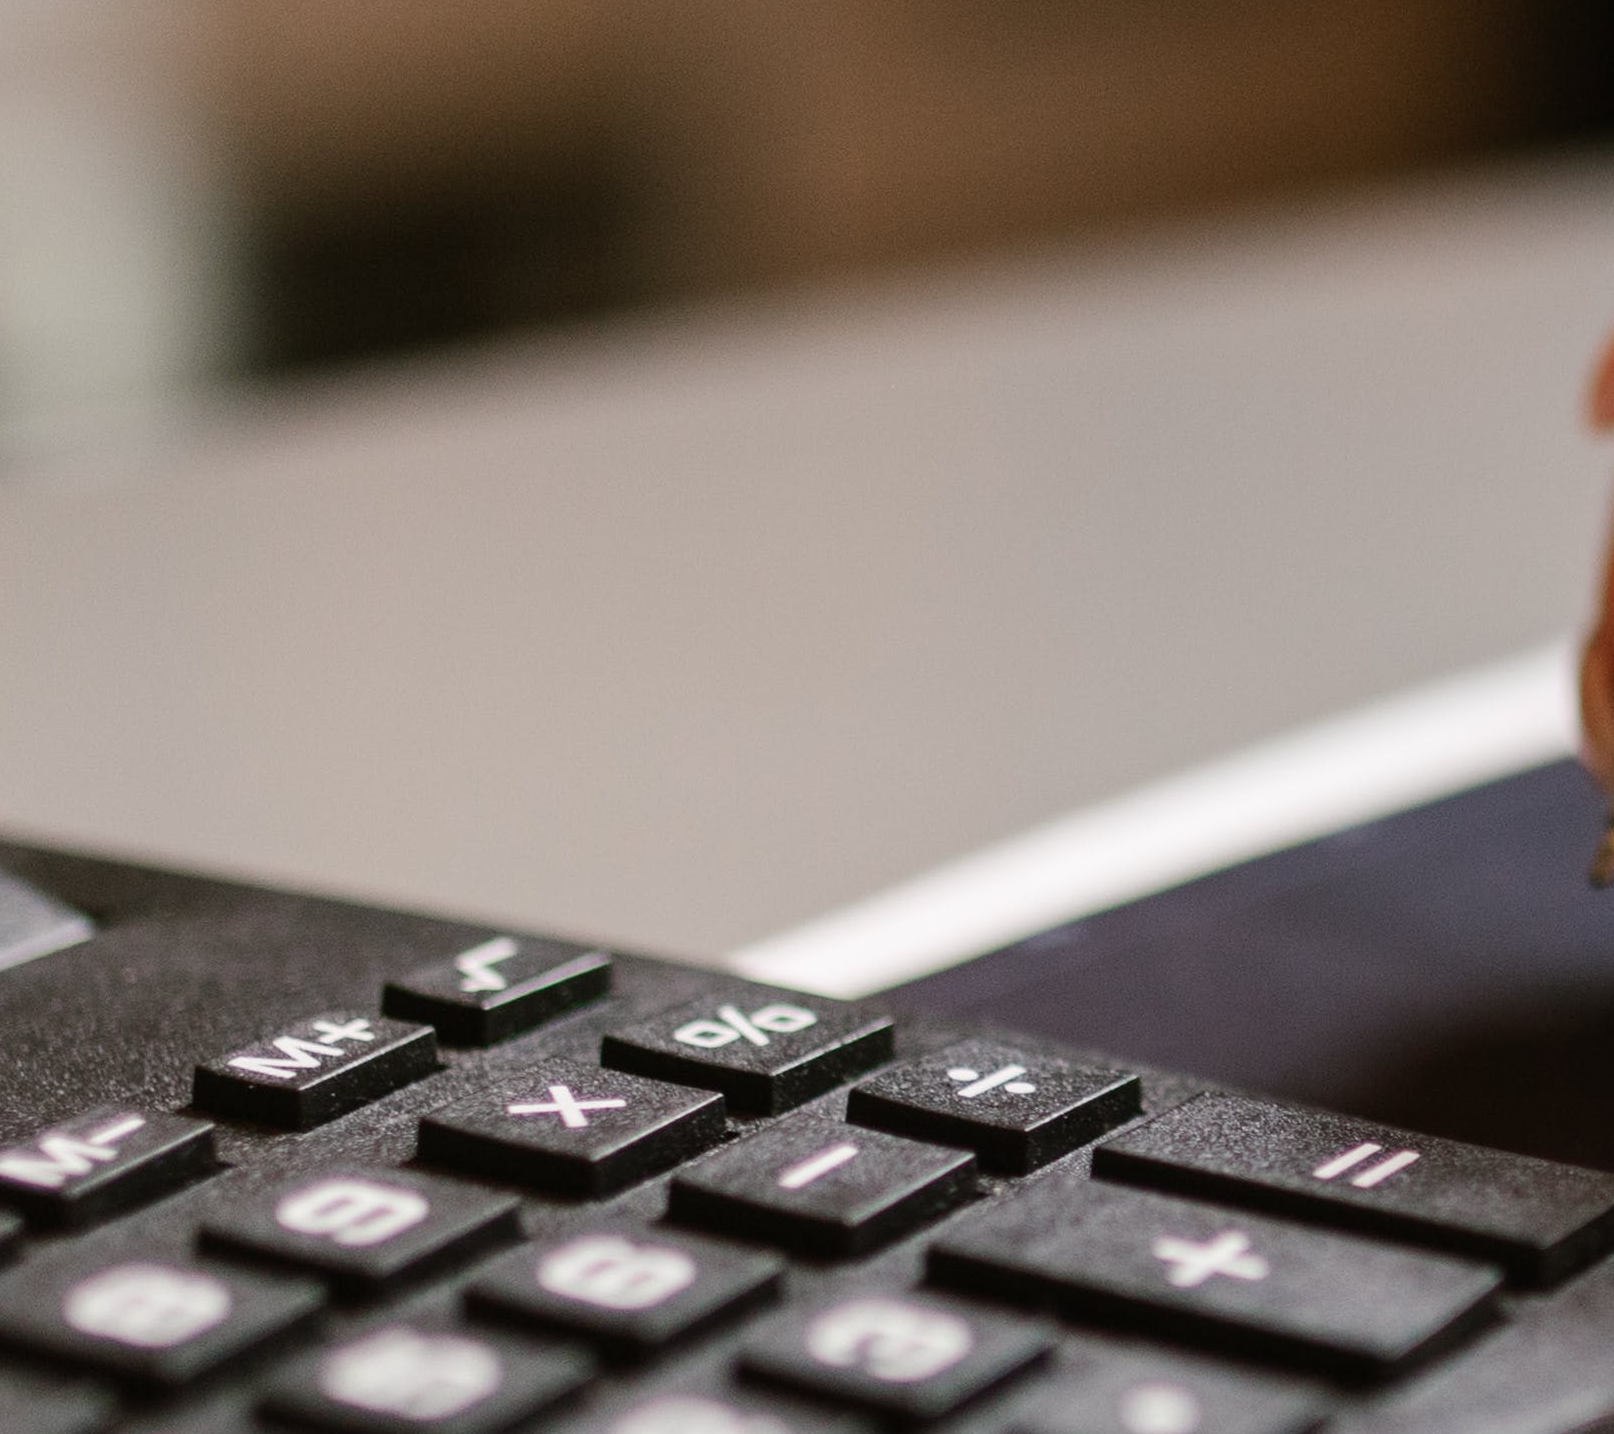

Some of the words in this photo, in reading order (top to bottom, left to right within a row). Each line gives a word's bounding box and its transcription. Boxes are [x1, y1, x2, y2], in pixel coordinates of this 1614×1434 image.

[228, 1019, 376, 1085] M+
[674, 1005, 816, 1048] %
[277, 1180, 427, 1244] 9
[801, 1293, 977, 1385] 3
